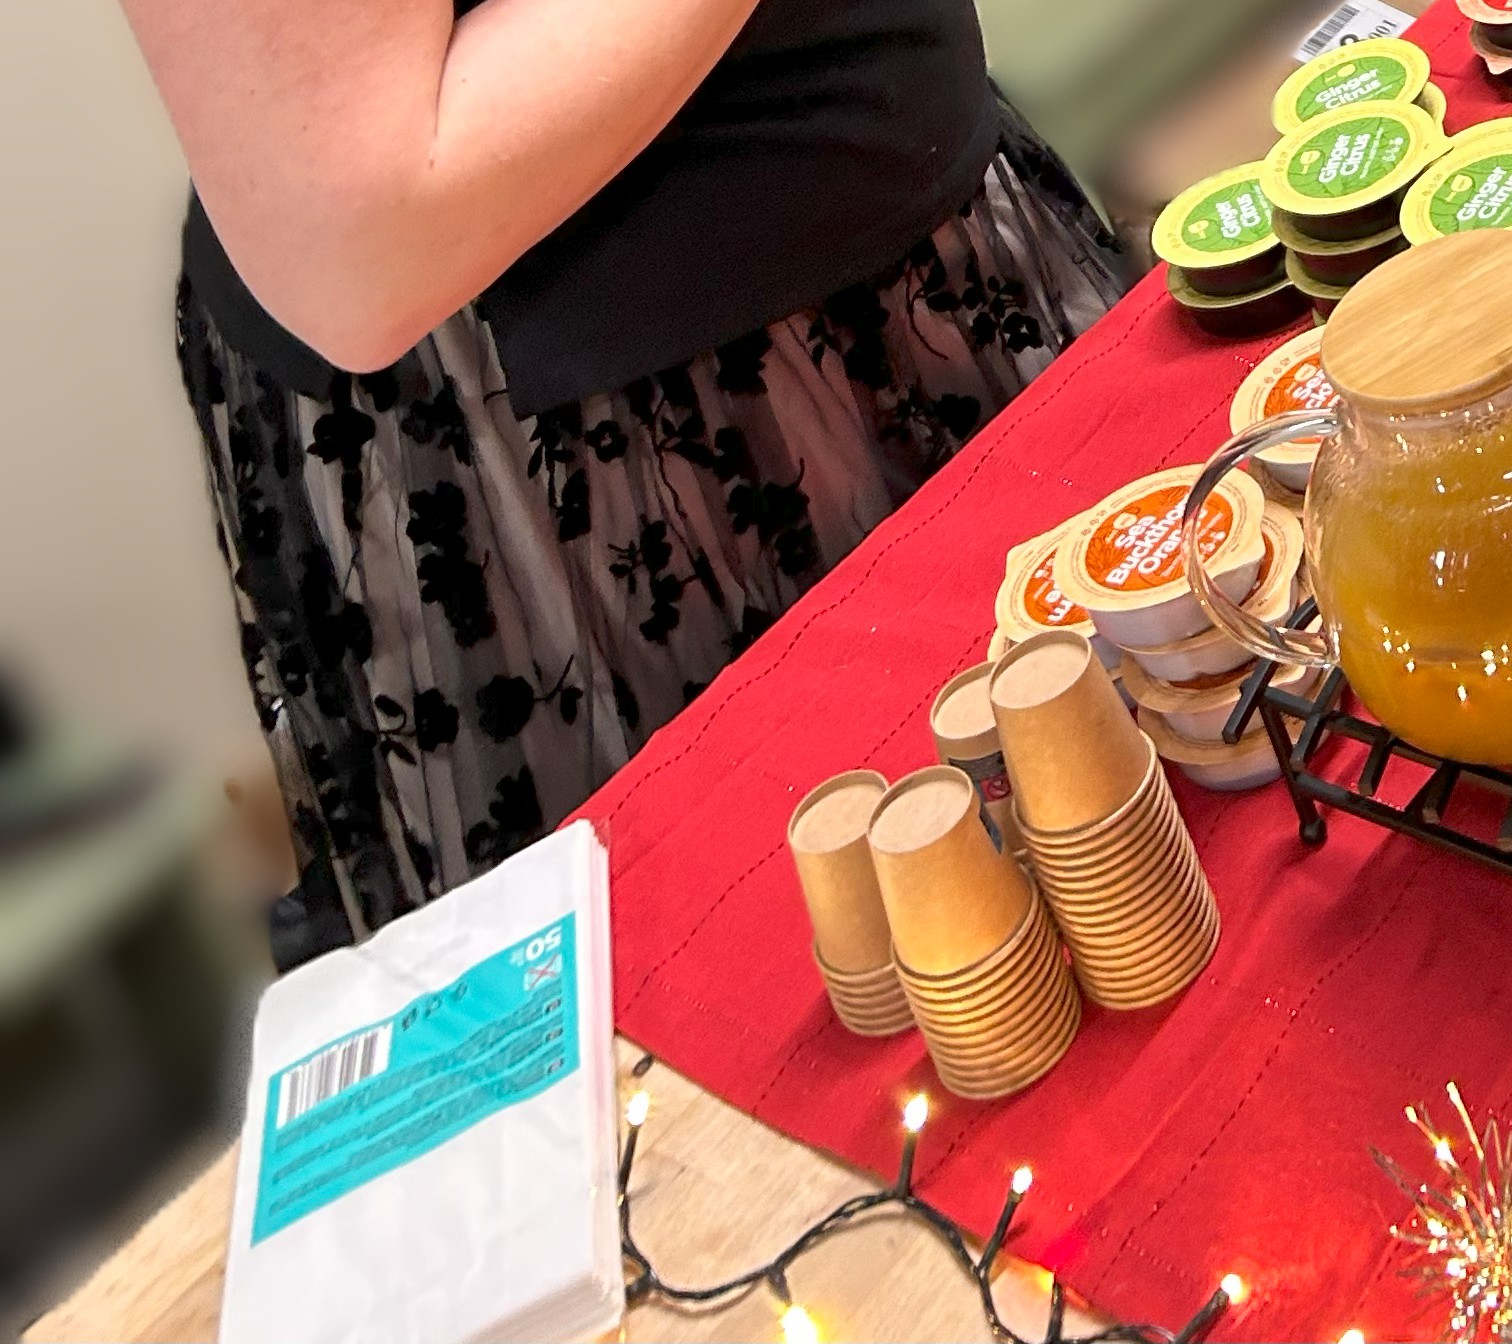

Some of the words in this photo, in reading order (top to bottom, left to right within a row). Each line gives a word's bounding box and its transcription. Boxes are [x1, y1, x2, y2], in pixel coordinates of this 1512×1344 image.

[1315, 69, 1378, 103] Ginger
[1326, 79, 1382, 109] Citrus
[1318, 134, 1351, 183] Ginger
[1340, 133, 1371, 176] Citrus
[1237, 193, 1261, 227] Citrus
[1457, 166, 1507, 221] Ginger
[1216, 201, 1241, 238] Ginger
[1105, 493, 1190, 586] Buckthor
[1114, 515, 1157, 549] Sea
[526, 926, 561, 961] 50
